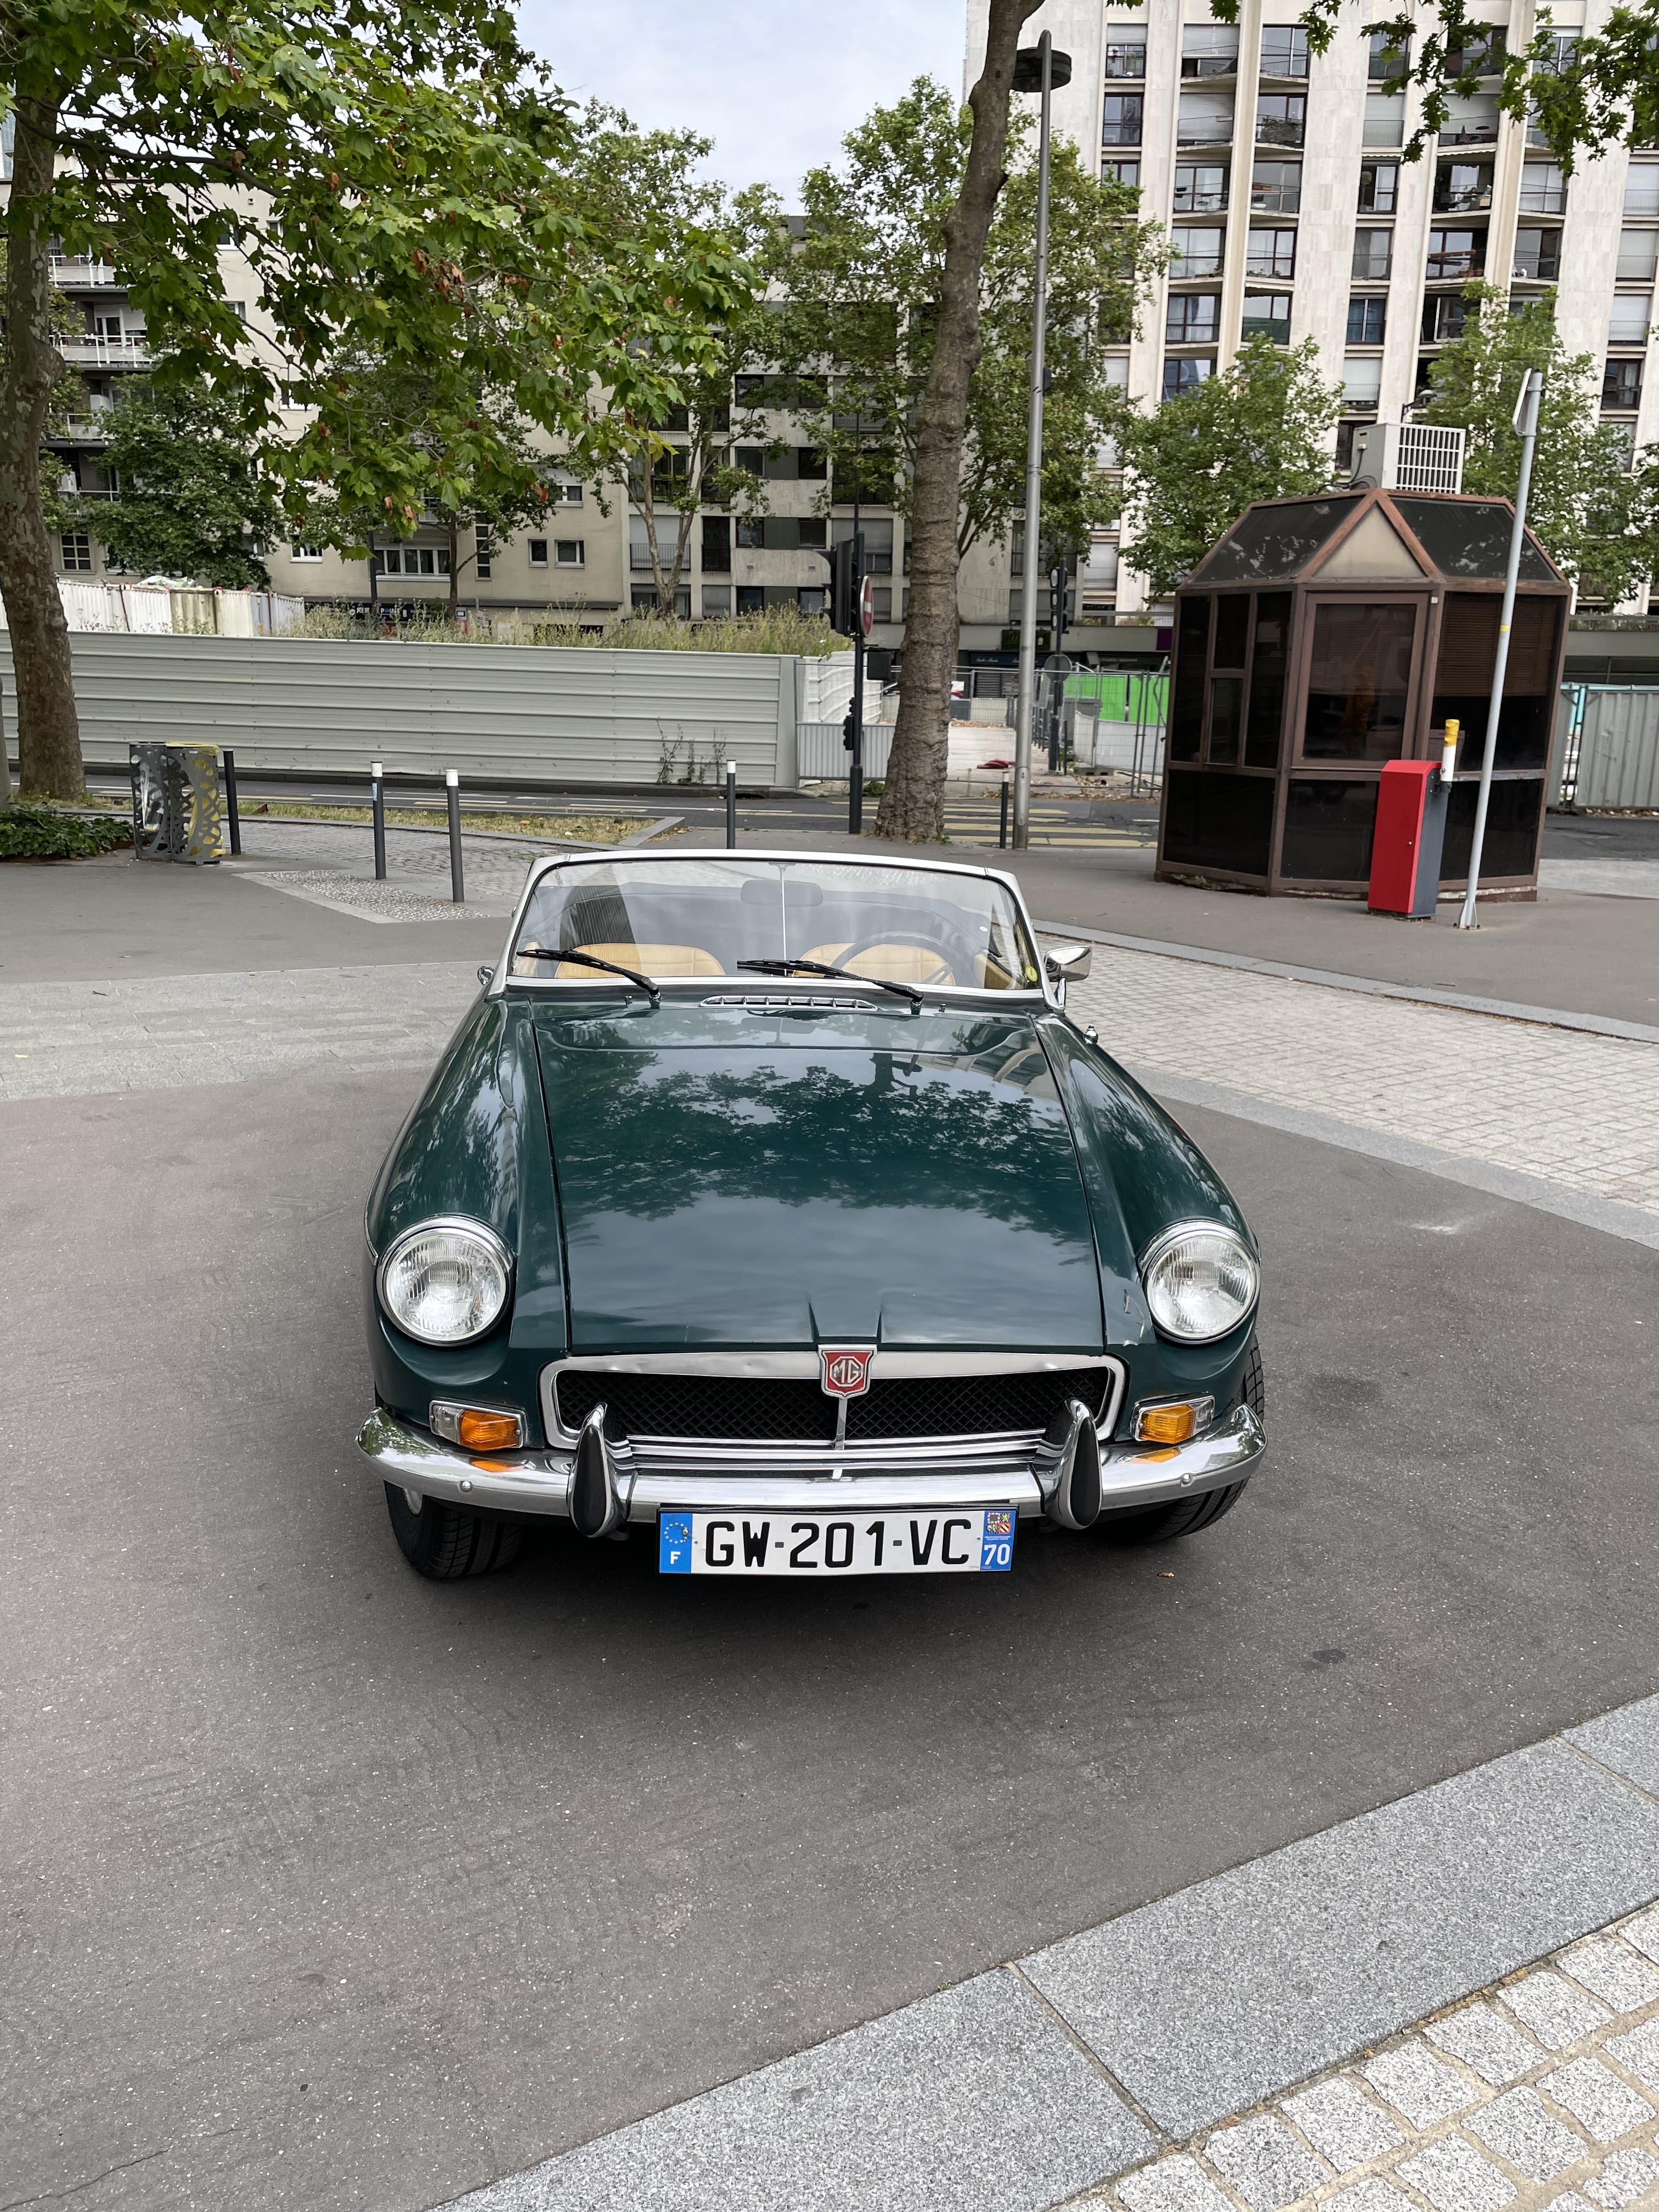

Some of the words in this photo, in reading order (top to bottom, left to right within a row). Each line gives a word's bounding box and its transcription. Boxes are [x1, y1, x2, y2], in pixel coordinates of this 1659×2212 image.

[833, 1359, 860, 1384] MG
[706, 1519, 971, 1568] GW-201-VC
[984, 1543, 1011, 1565] 70
[670, 1551, 681, 1565] F
